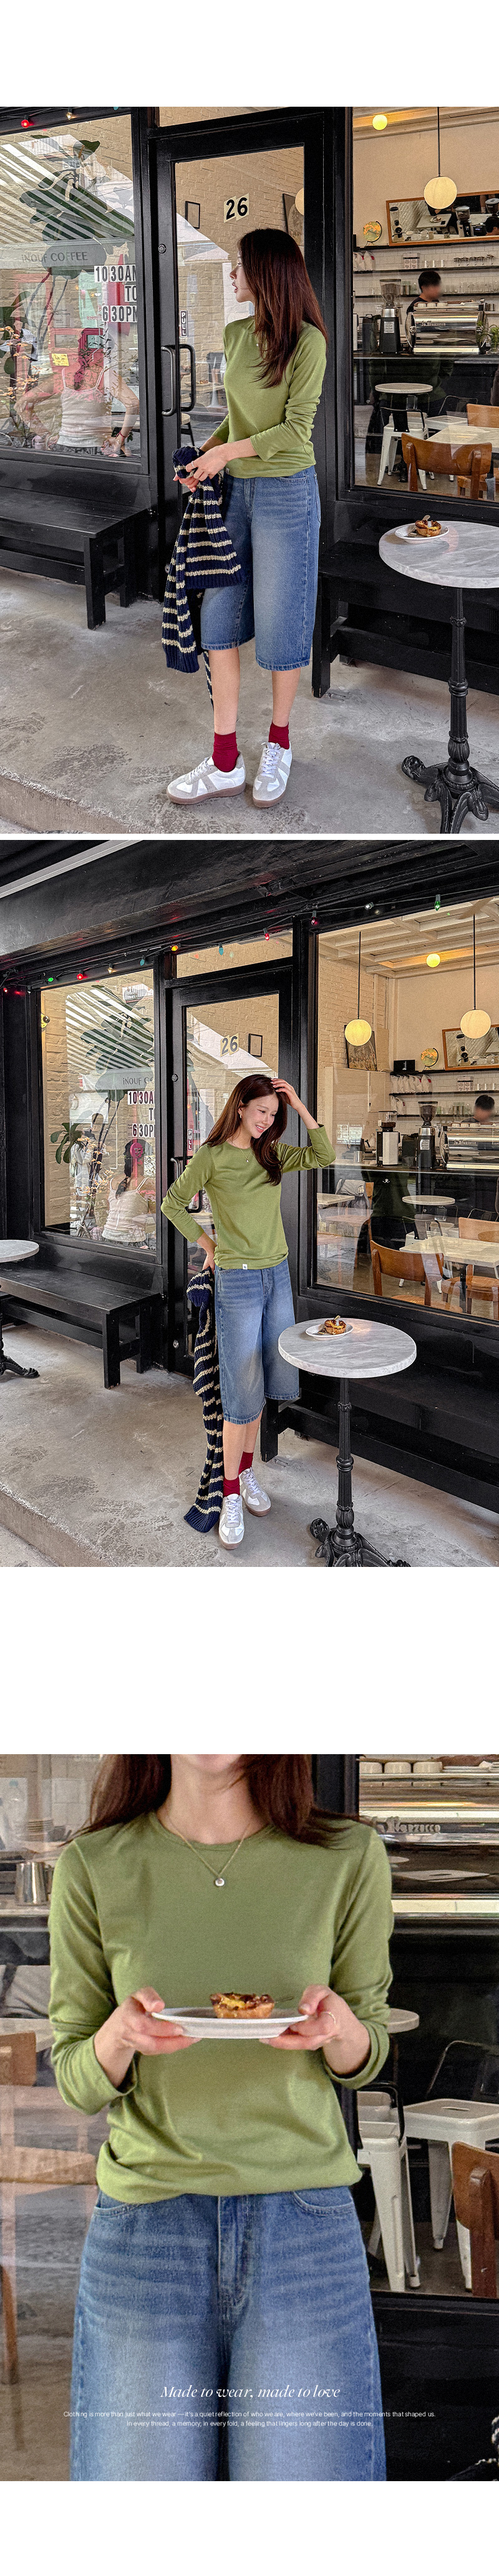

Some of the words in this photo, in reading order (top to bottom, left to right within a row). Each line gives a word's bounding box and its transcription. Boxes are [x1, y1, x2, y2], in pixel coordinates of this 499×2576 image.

[226, 197, 248, 220] 26
[51, 251, 88, 261] COFFEE
[221, 1036, 238, 1055] 26
